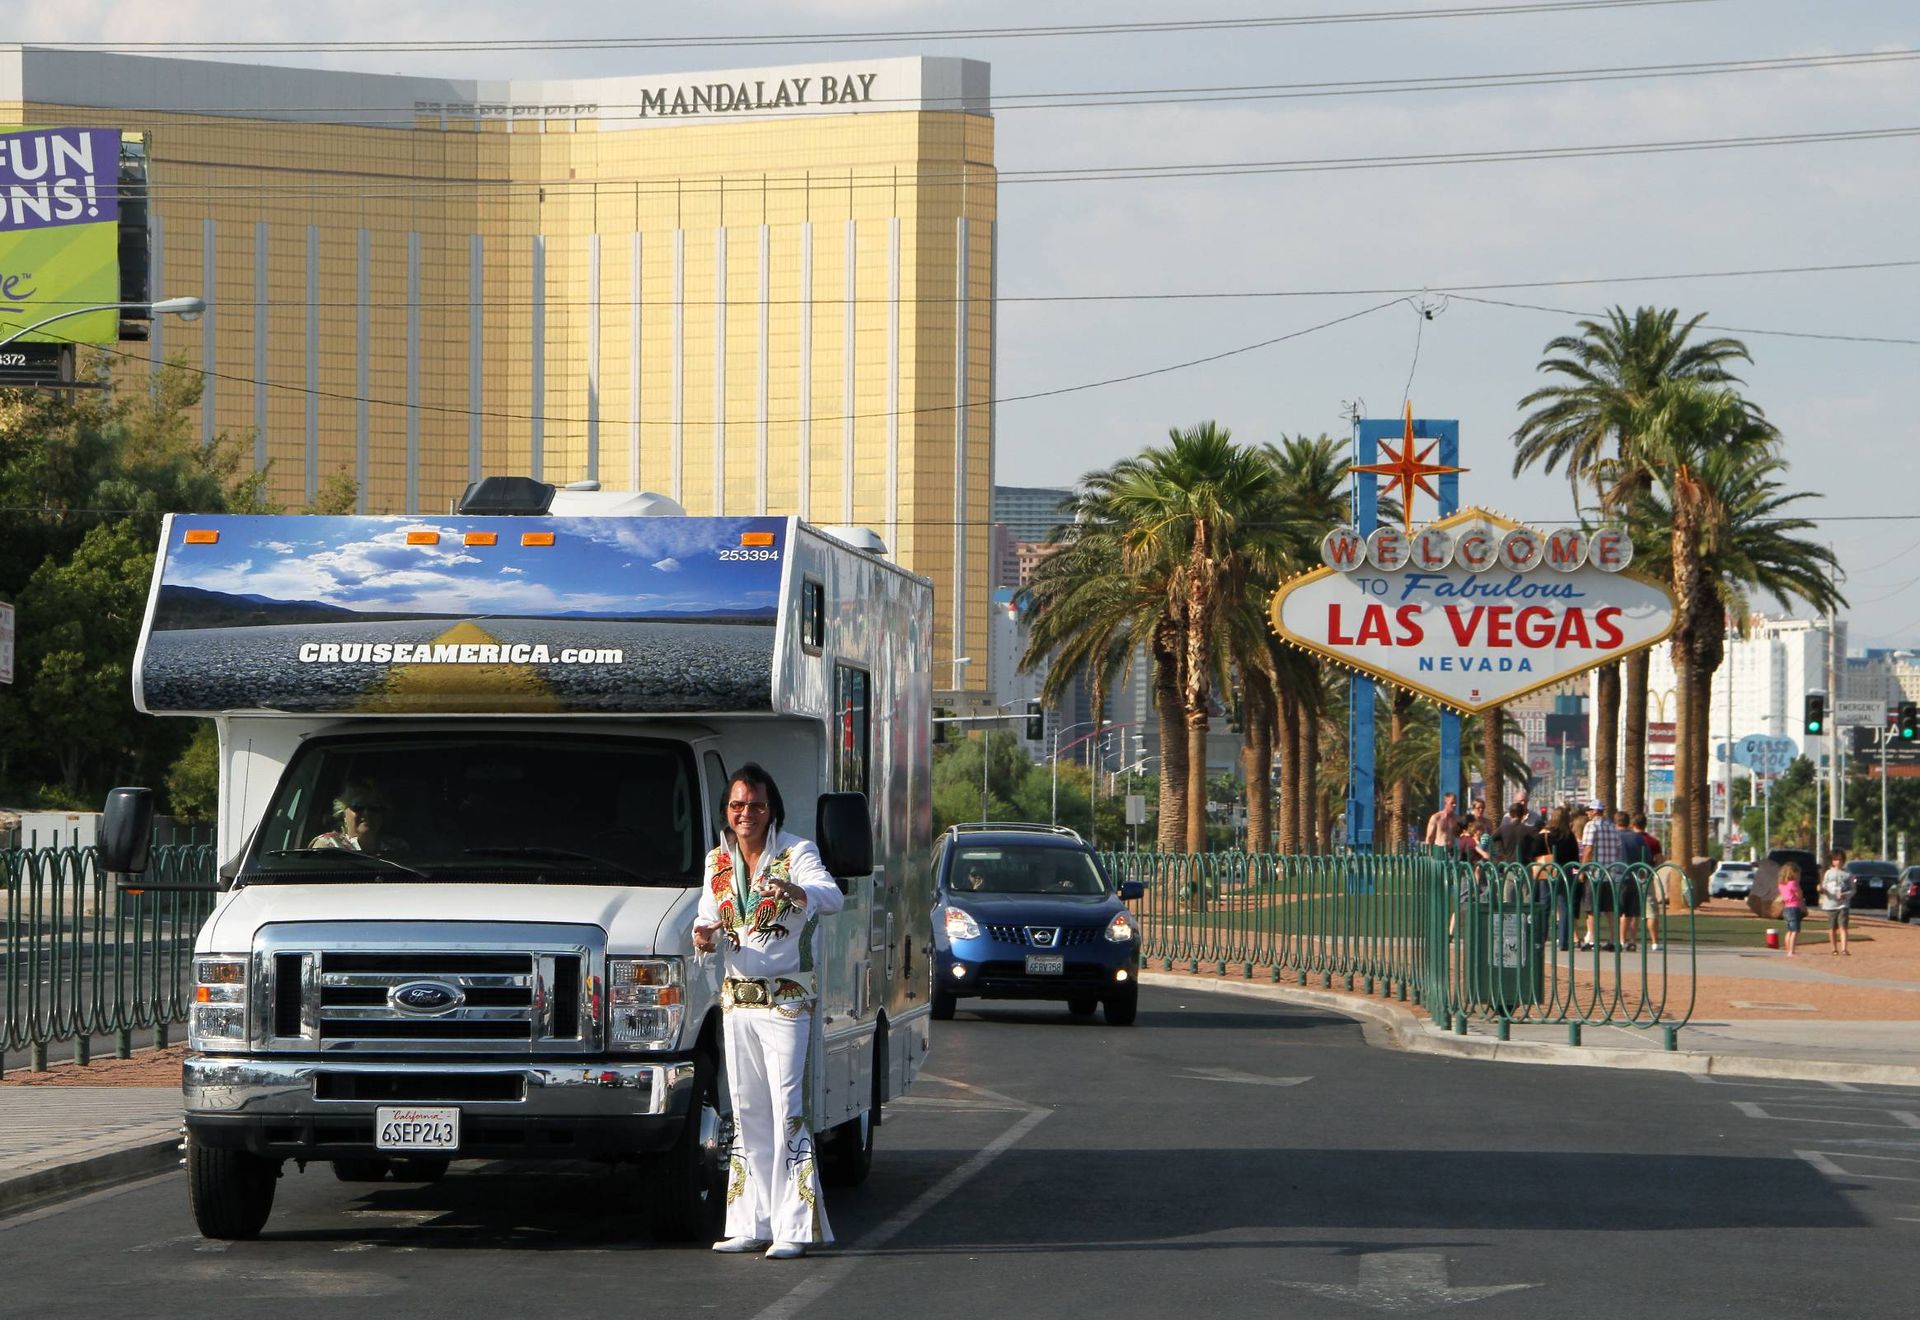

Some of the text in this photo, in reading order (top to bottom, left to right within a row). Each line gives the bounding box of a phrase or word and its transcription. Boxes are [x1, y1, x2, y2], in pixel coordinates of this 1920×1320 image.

[639, 74, 877, 117] MANDALAY BAY
[0, 132, 94, 180] UN
[0, 175, 99, 225] NS!
[0, 353, 26, 366] 372
[718, 549, 780, 562] 253394
[1327, 535, 1621, 564] WELCOME
[1356, 573, 1586, 600] TO Fabulous
[1327, 603, 1625, 649] LAS VEGAS
[299, 642, 624, 665] CRUISEAMERICA.com
[1418, 656, 1533, 673] NEVADA
[1838, 703, 1880, 712] EMERGENCY
[1747, 740, 1790, 753] GLASS
[1750, 753, 1785, 767] POOL
[409, 989, 441, 1003] Ford
[393, 1111, 443, 1123] California
[382, 1122, 453, 1143] 6SEP243
